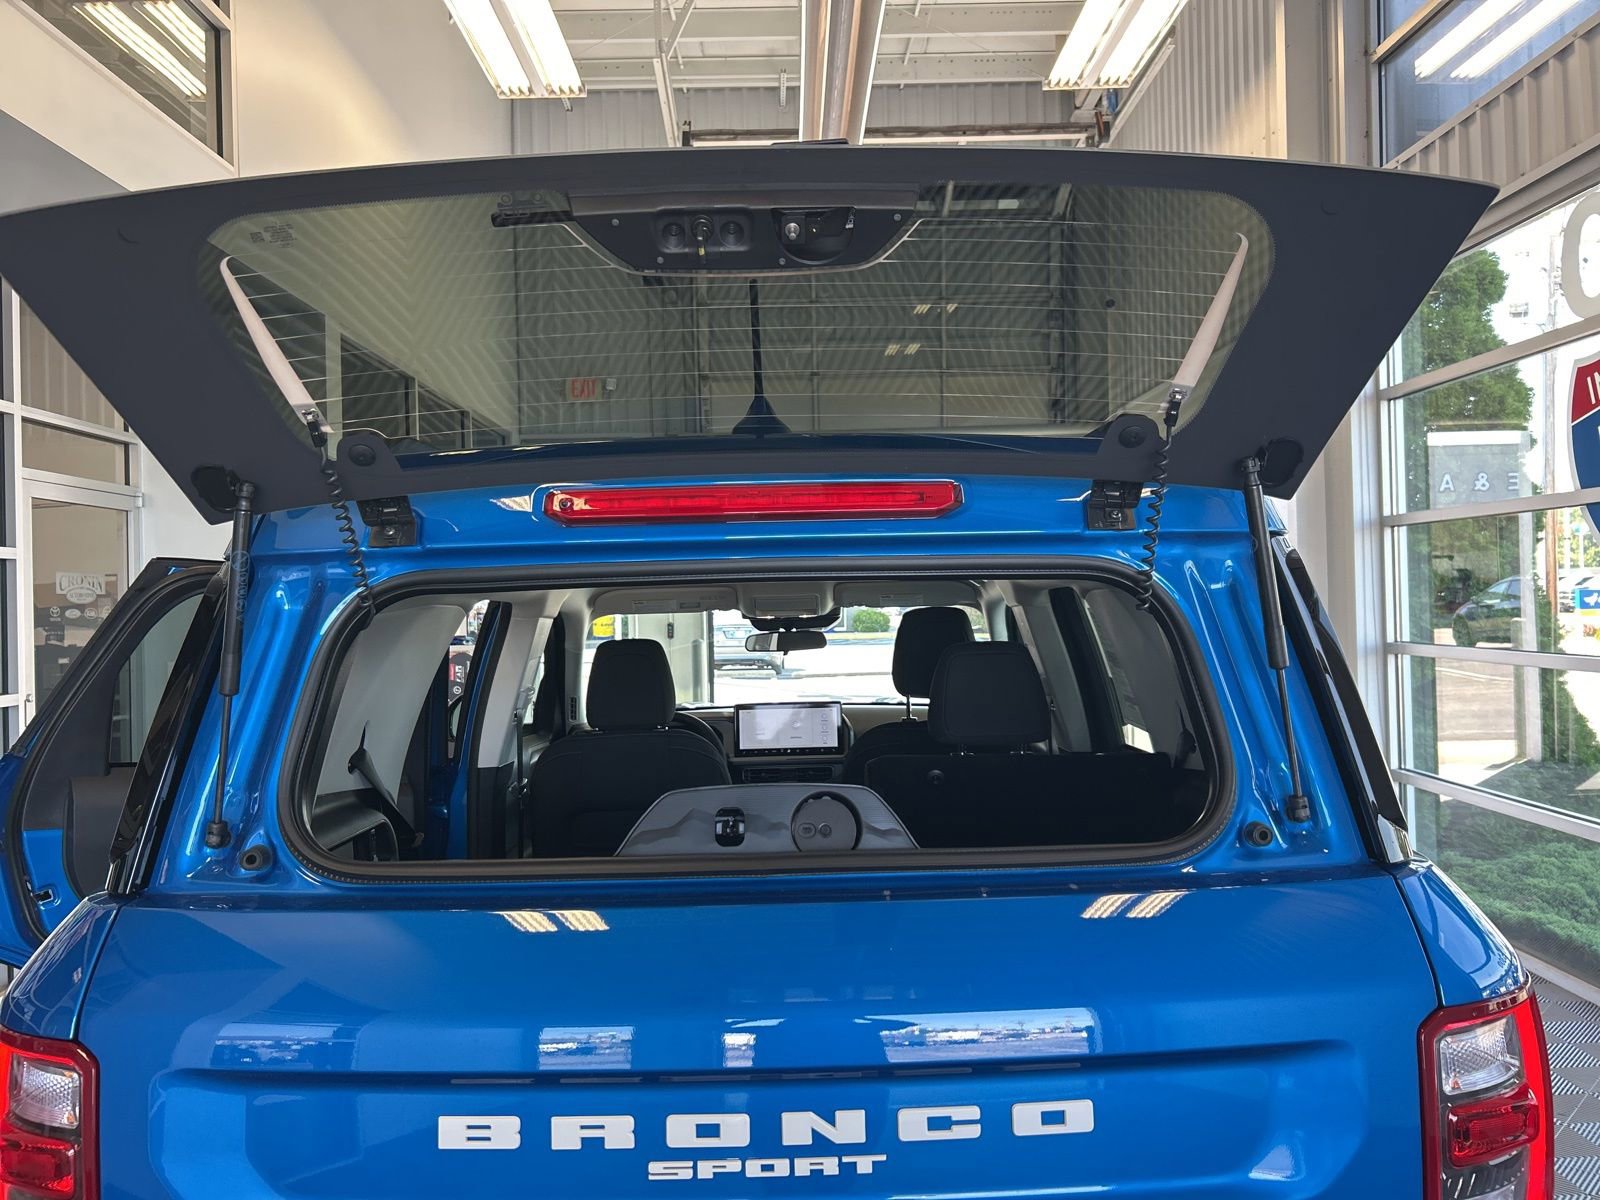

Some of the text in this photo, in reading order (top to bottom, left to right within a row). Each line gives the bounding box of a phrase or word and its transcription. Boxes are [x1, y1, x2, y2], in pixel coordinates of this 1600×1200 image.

[571, 379, 598, 399] EXIT
[59, 574, 104, 593] CRONIN
[438, 1099, 1095, 1150] BRONCO
[648, 1153, 887, 1180] SPORT
